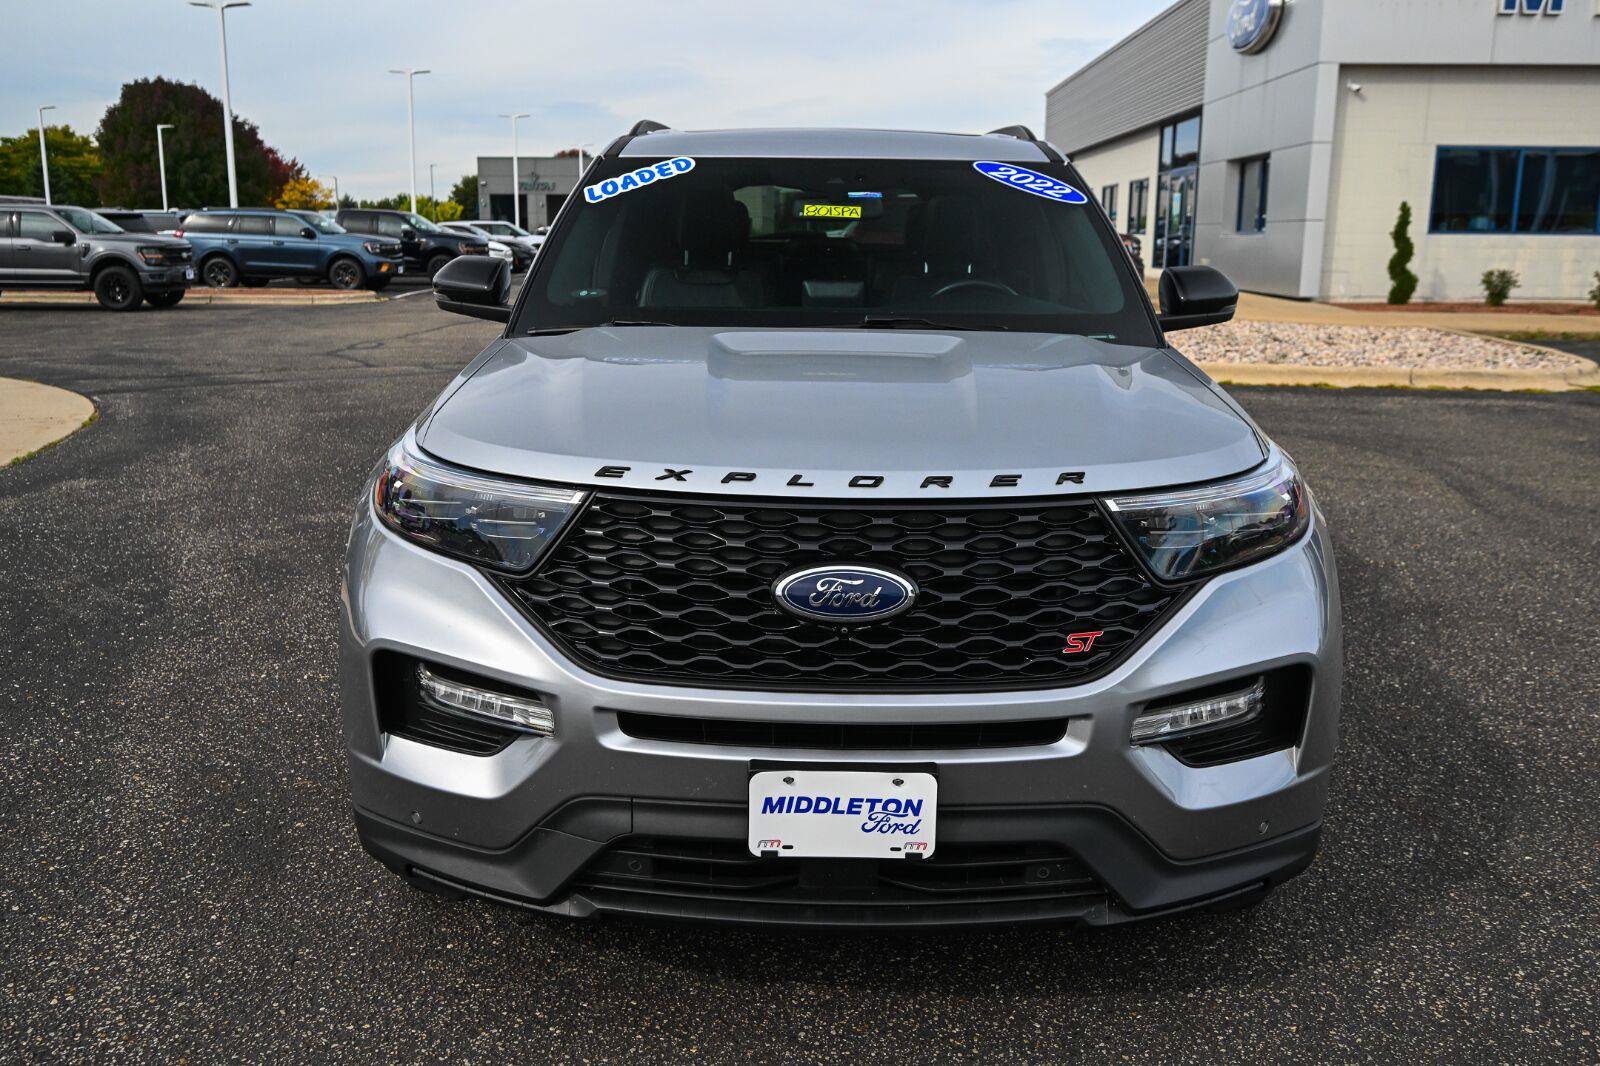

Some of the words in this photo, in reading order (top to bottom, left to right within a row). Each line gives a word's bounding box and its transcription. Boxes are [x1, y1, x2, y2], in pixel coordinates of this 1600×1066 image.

[587, 158, 692, 201] LOADED
[987, 166, 1073, 198] 2022
[594, 465, 1087, 489] EXPLORER
[808, 577, 883, 608] Ford
[1062, 631, 1104, 653] ST
[761, 796, 924, 817] MIDDLETON
[861, 811, 922, 835] Ford
